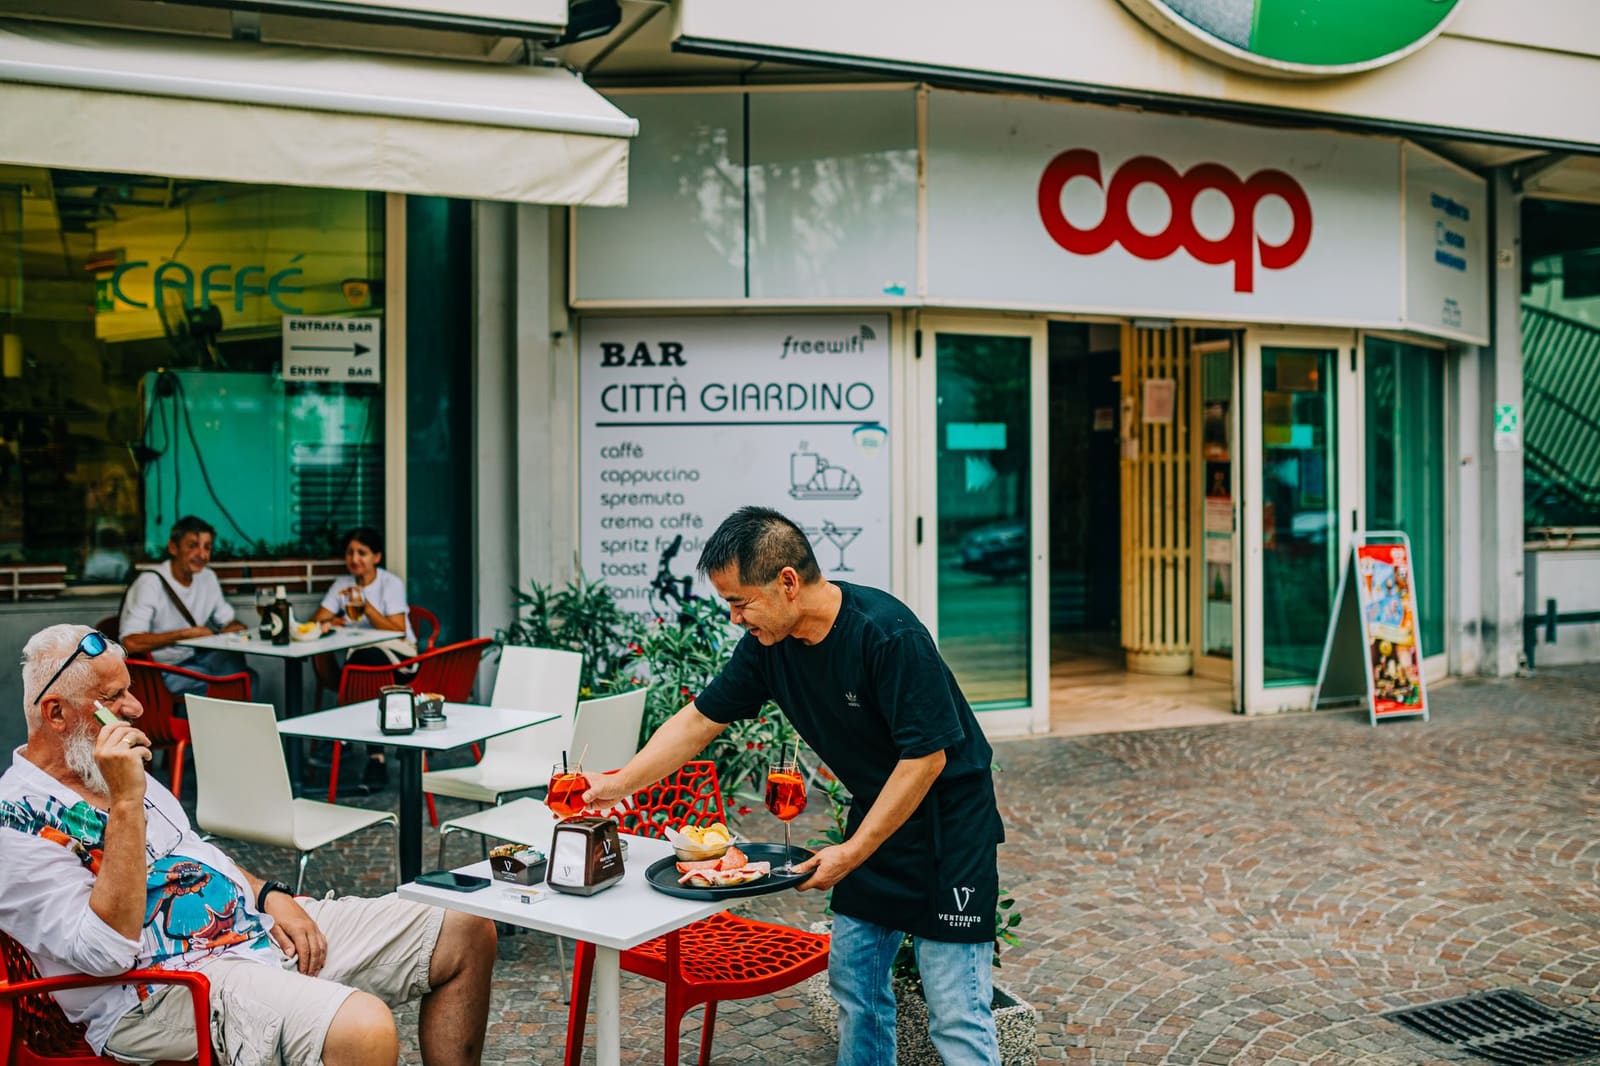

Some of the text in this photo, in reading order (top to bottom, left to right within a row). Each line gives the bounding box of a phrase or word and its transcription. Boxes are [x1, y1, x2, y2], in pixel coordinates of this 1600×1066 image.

[1037, 147, 1313, 293] coop
[289, 321, 373, 333] ENTRATA BAR
[600, 342, 687, 368] BAR
[289, 365, 373, 377] ENTRY BAR
[601, 377, 875, 413] CITTÀ GIARDINO
[600, 468, 701, 487] cappuccino
[600, 492, 685, 511] spremuta
[600, 516, 654, 530] crema
[600, 538, 649, 557] spritz
[600, 562, 648, 577] toast
[938, 913, 981, 922] VENTURATO
